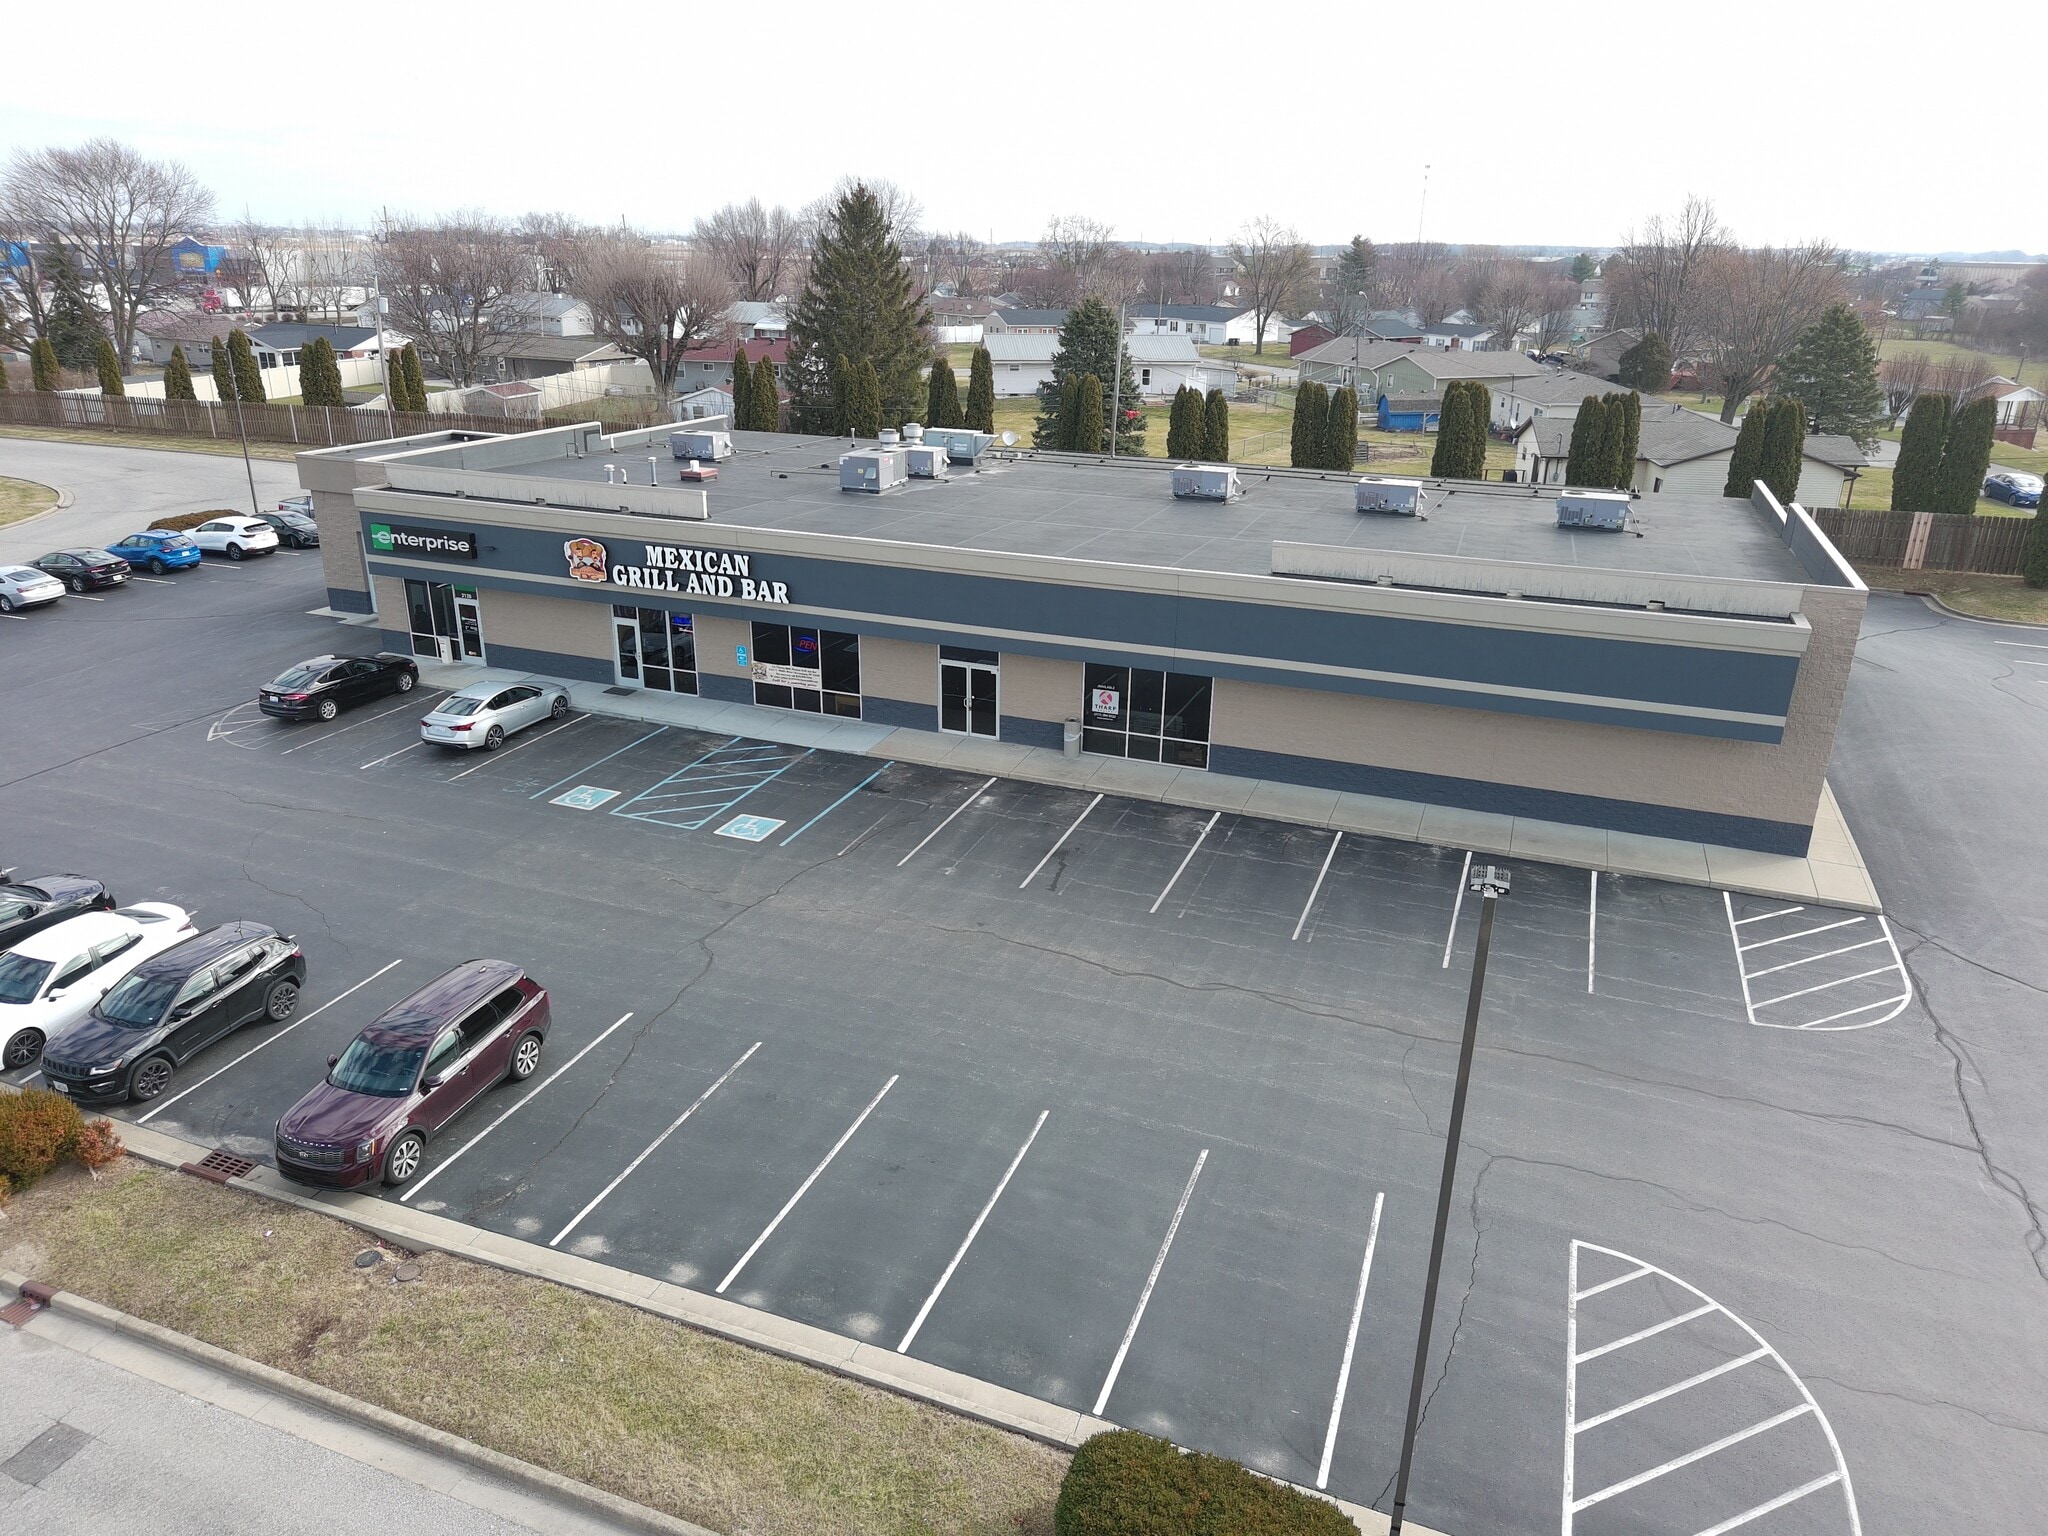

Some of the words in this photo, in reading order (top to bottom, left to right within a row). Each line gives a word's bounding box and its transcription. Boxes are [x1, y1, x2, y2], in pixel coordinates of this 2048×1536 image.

[372, 531, 470, 552] enterprise
[645, 545, 749, 577] MEXICAN
[612, 564, 679, 592] GRILL
[686, 573, 733, 598] AND
[740, 578, 789, 604] BAR
[798, 640, 817, 650] PEN
